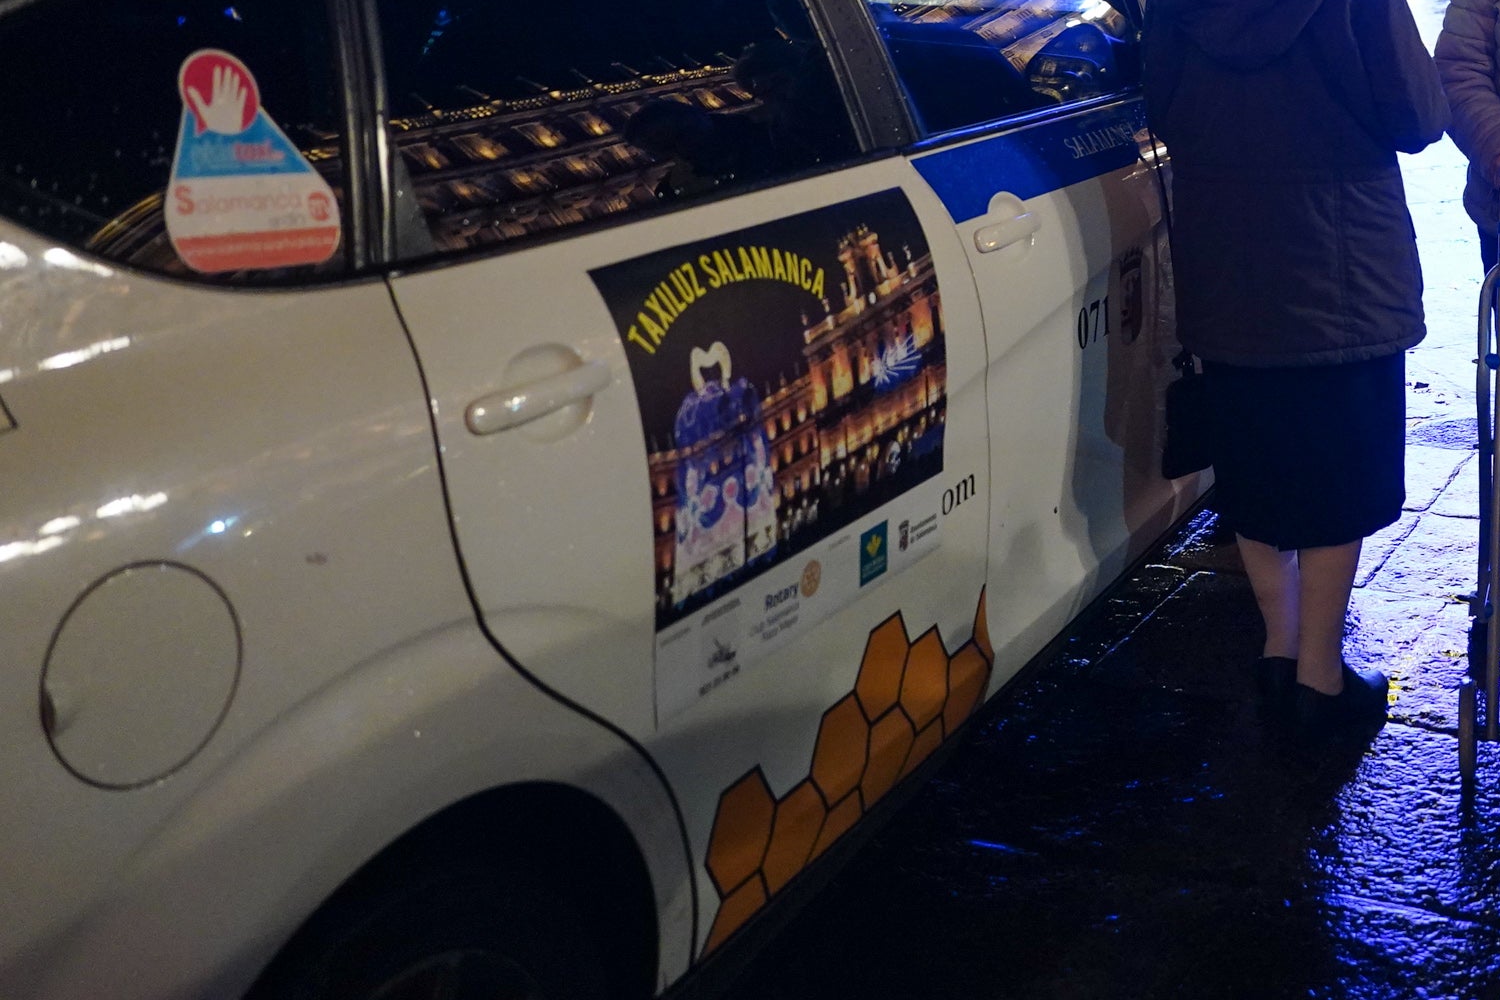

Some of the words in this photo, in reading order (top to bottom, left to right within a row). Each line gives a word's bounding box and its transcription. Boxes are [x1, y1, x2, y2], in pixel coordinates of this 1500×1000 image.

[627, 262, 707, 355] TAXILUZ
[698, 246, 825, 300] SALAMANCA
[1077, 295, 1110, 349] 071
